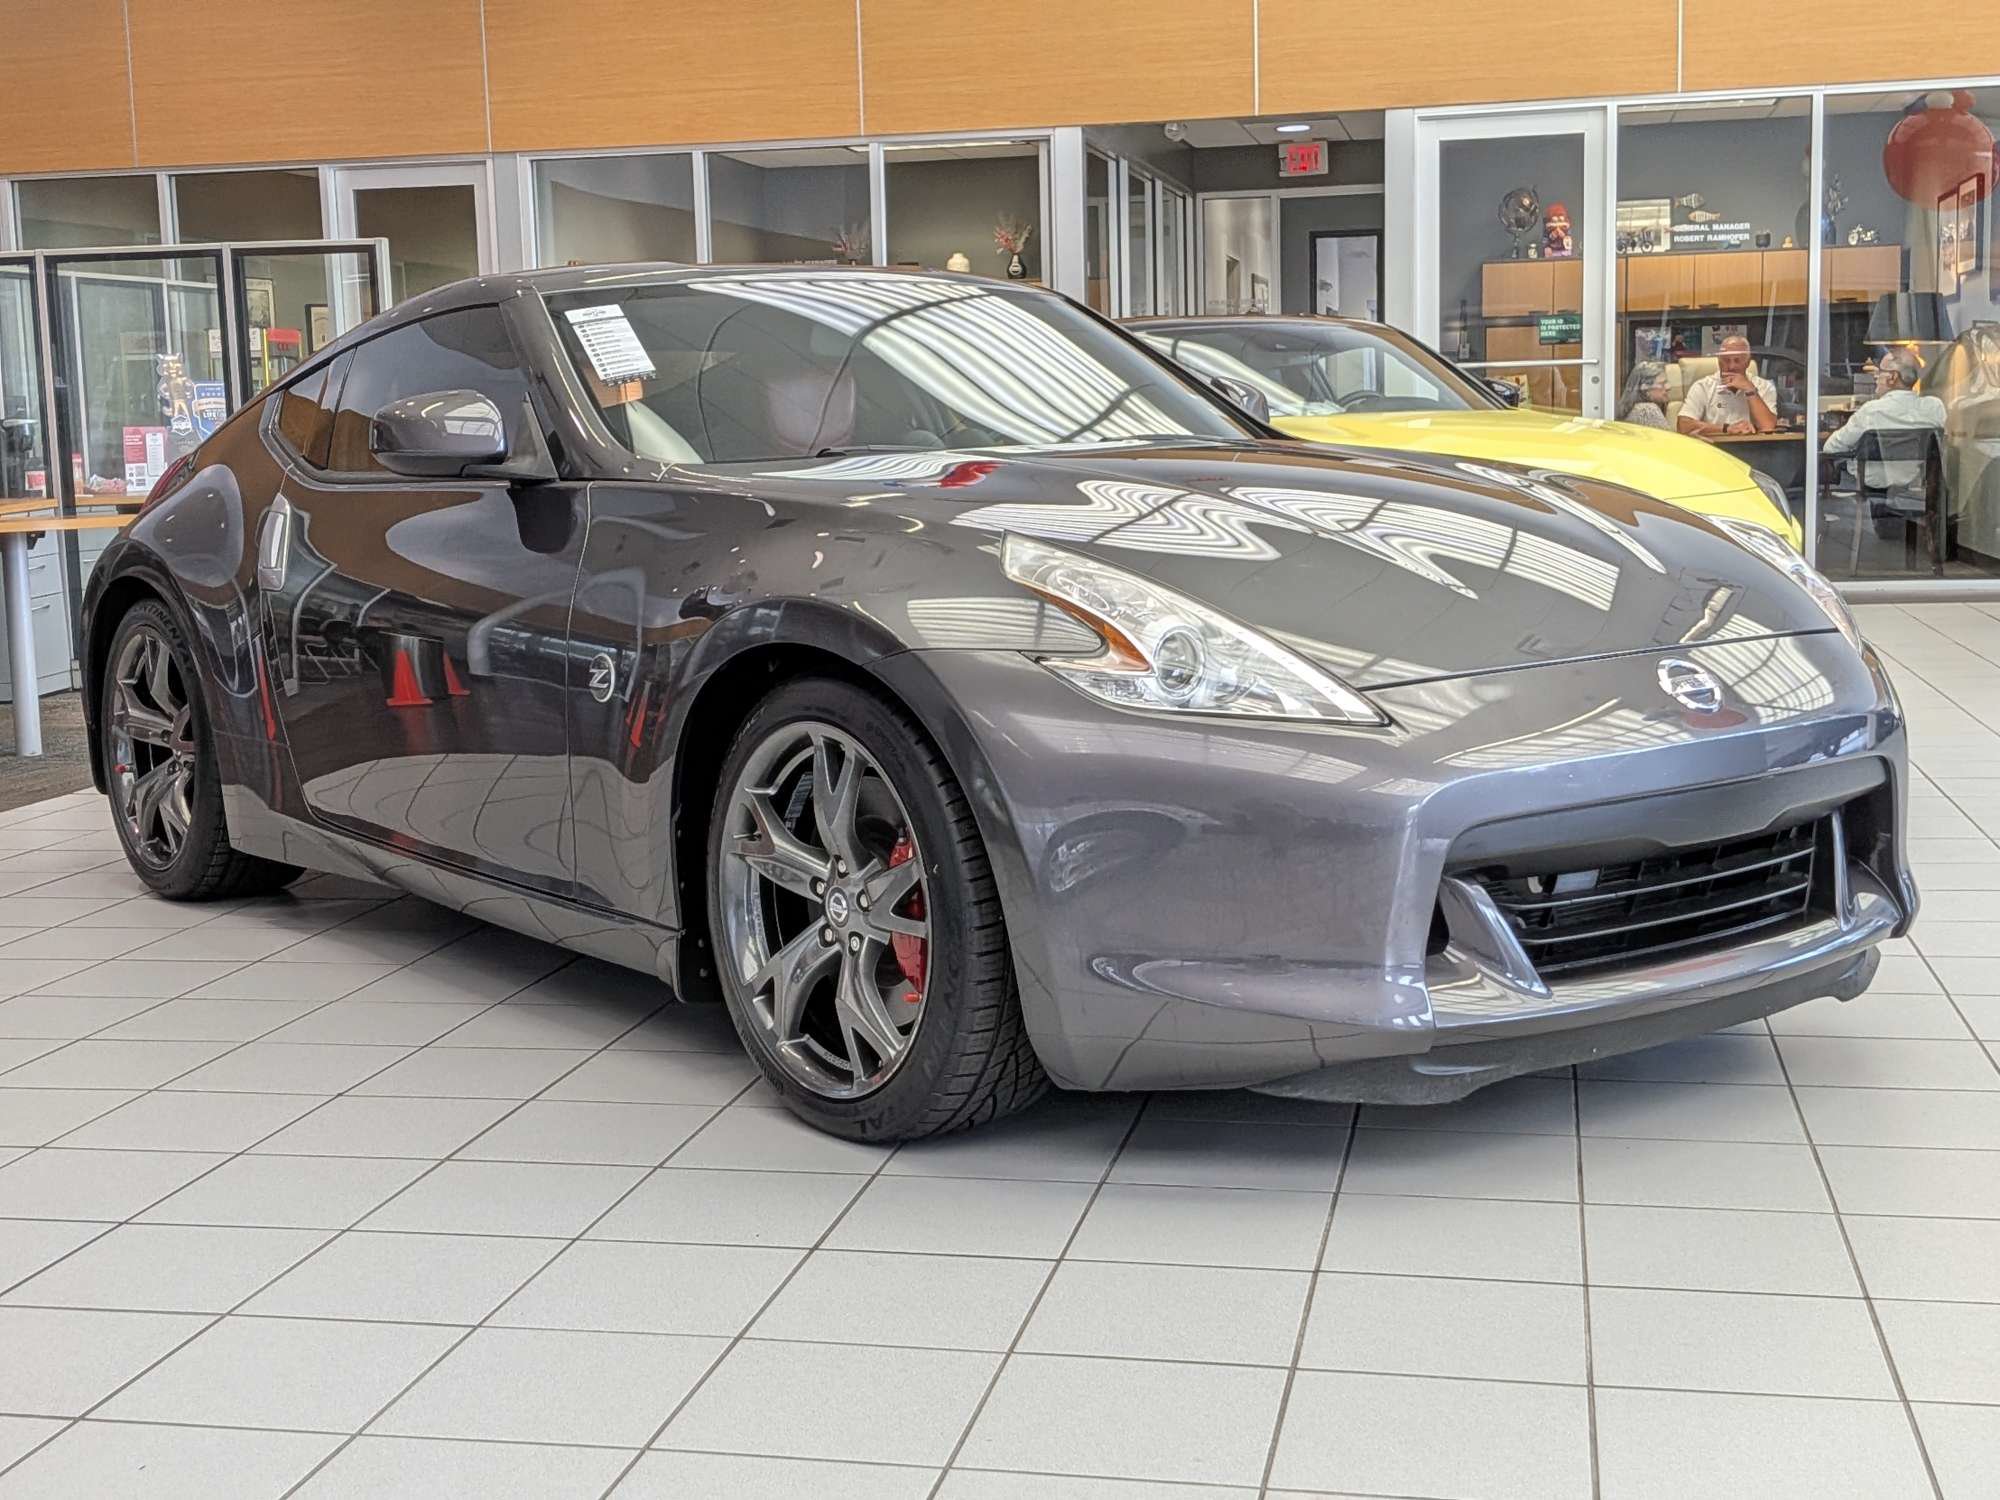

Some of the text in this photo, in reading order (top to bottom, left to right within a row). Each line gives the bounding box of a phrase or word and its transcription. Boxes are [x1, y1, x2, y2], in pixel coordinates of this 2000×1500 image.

[1712, 222, 1751, 230] MANAGER
[1673, 234, 1705, 242] ROBERT
[589, 668, 609, 689] Z
